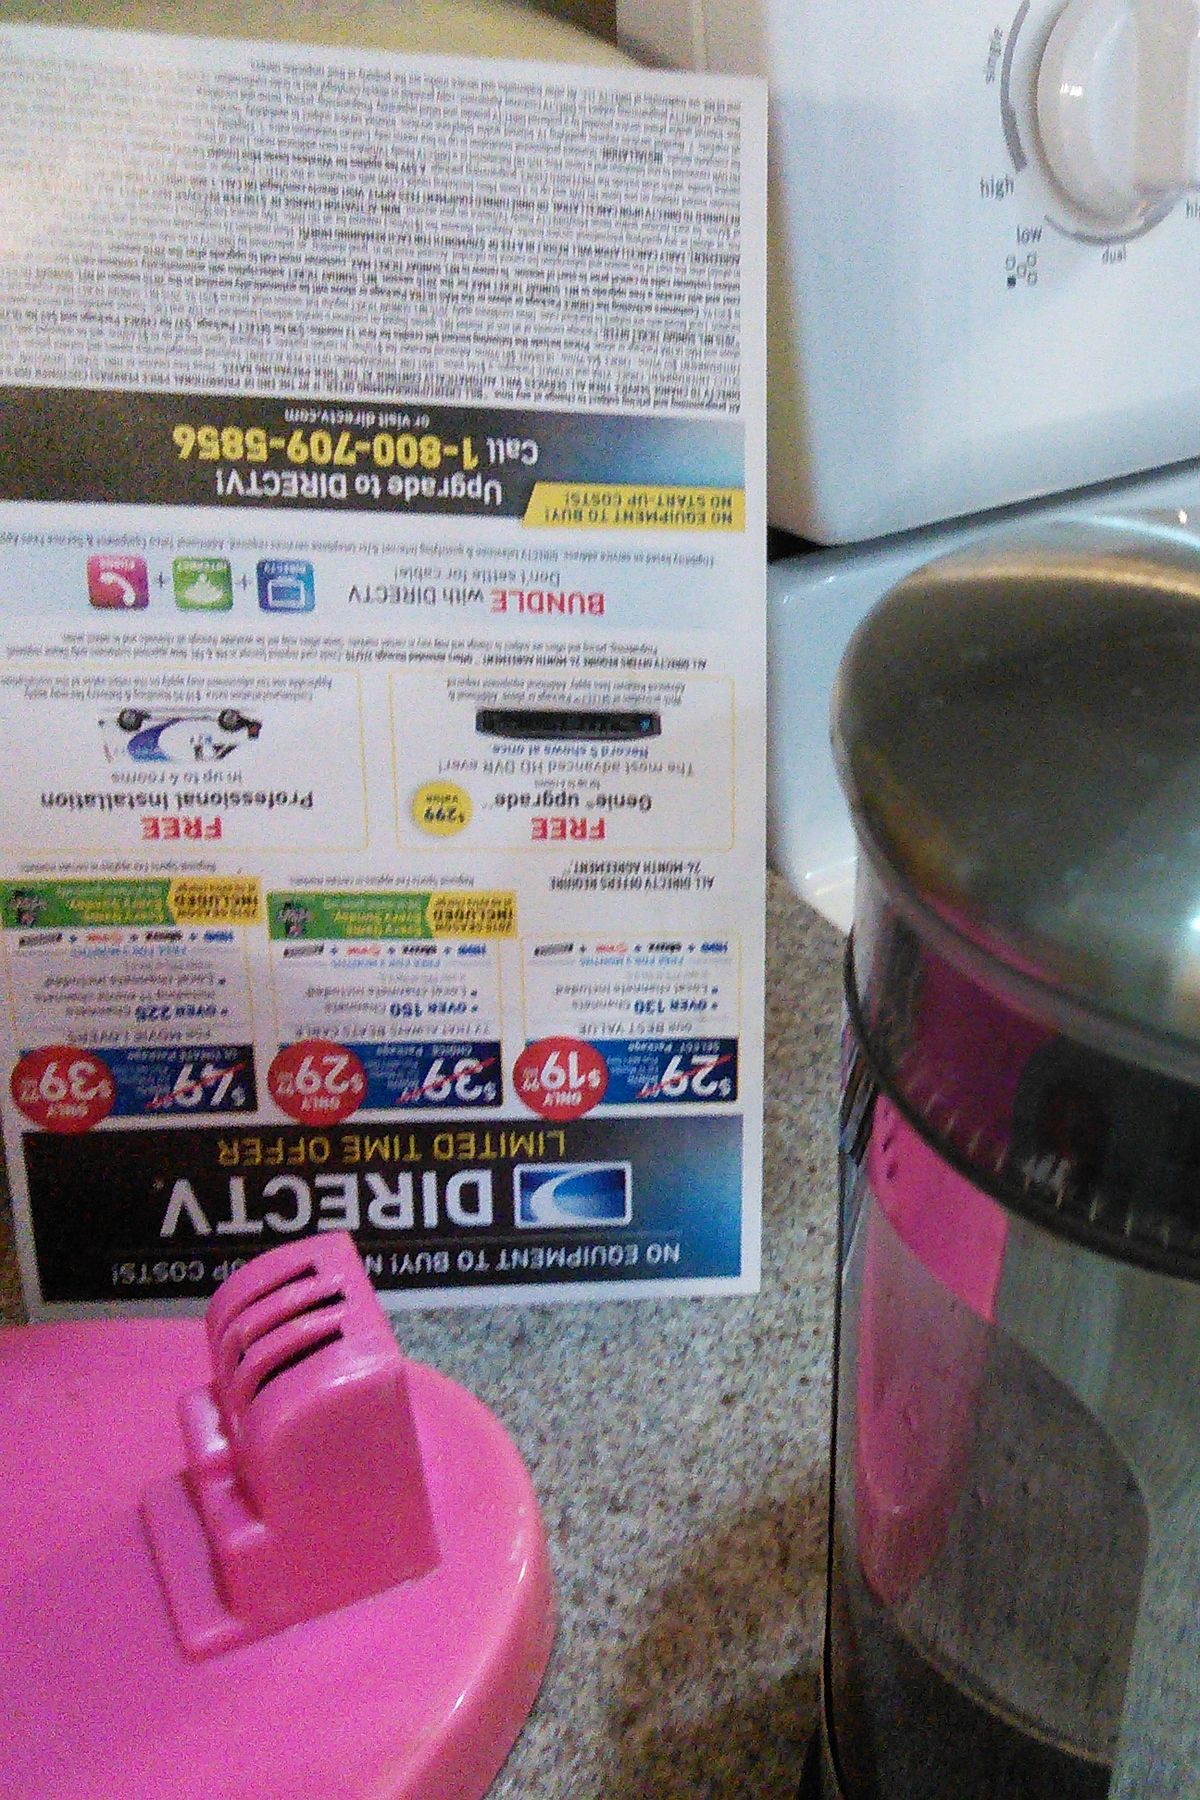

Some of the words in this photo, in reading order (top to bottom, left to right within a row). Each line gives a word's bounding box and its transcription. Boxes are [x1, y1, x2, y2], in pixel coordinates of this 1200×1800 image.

[980, 174, 1014, 199] high
[1016, 225, 1043, 245] low
[1101, 244, 1128, 265] dual
[171, 422, 480, 471] 1-800-709-5856
[485, 435, 539, 468] Call
[214, 467, 347, 499] DIRECTV!
[354, 472, 382, 499] to
[387, 468, 503, 506] Upgrade
[709, 494, 733, 508] NO
[586, 508, 608, 522] TO
[612, 508, 707, 524] EQUIPMENT
[710, 510, 734, 524] NO
[445, 566, 469, 586] for
[472, 567, 517, 586] settle
[520, 569, 561, 588] Don't
[348, 584, 437, 606] DIRECTV
[441, 588, 485, 607] with
[489, 589, 606, 616] BUNDLE
[110, 770, 167, 785] rooms
[183, 770, 201, 784] to
[201, 767, 225, 784] up
[226, 770, 243, 784] in
[481, 759, 516, 776] DVR
[547, 760, 622, 776] advanced
[623, 760, 664, 776] most
[666, 761, 695, 777] The
[40, 790, 169, 812] Installation
[175, 788, 314, 812] Professional
[139, 815, 223, 842] FREE
[530, 816, 606, 842] FREE
[215, 1136, 331, 1168] OFFER
[340, 1133, 424, 1164] TIME
[432, 1129, 565, 1162] LIMITED
[158, 1168, 493, 1238] DIRECTV
[390, 1251, 451, 1276] BUY!
[457, 1249, 490, 1275] TO
[495, 1244, 639, 1272] EQUIPMENT
[645, 1242, 680, 1264] NO
[110, 1260, 205, 1286] COSTS!
